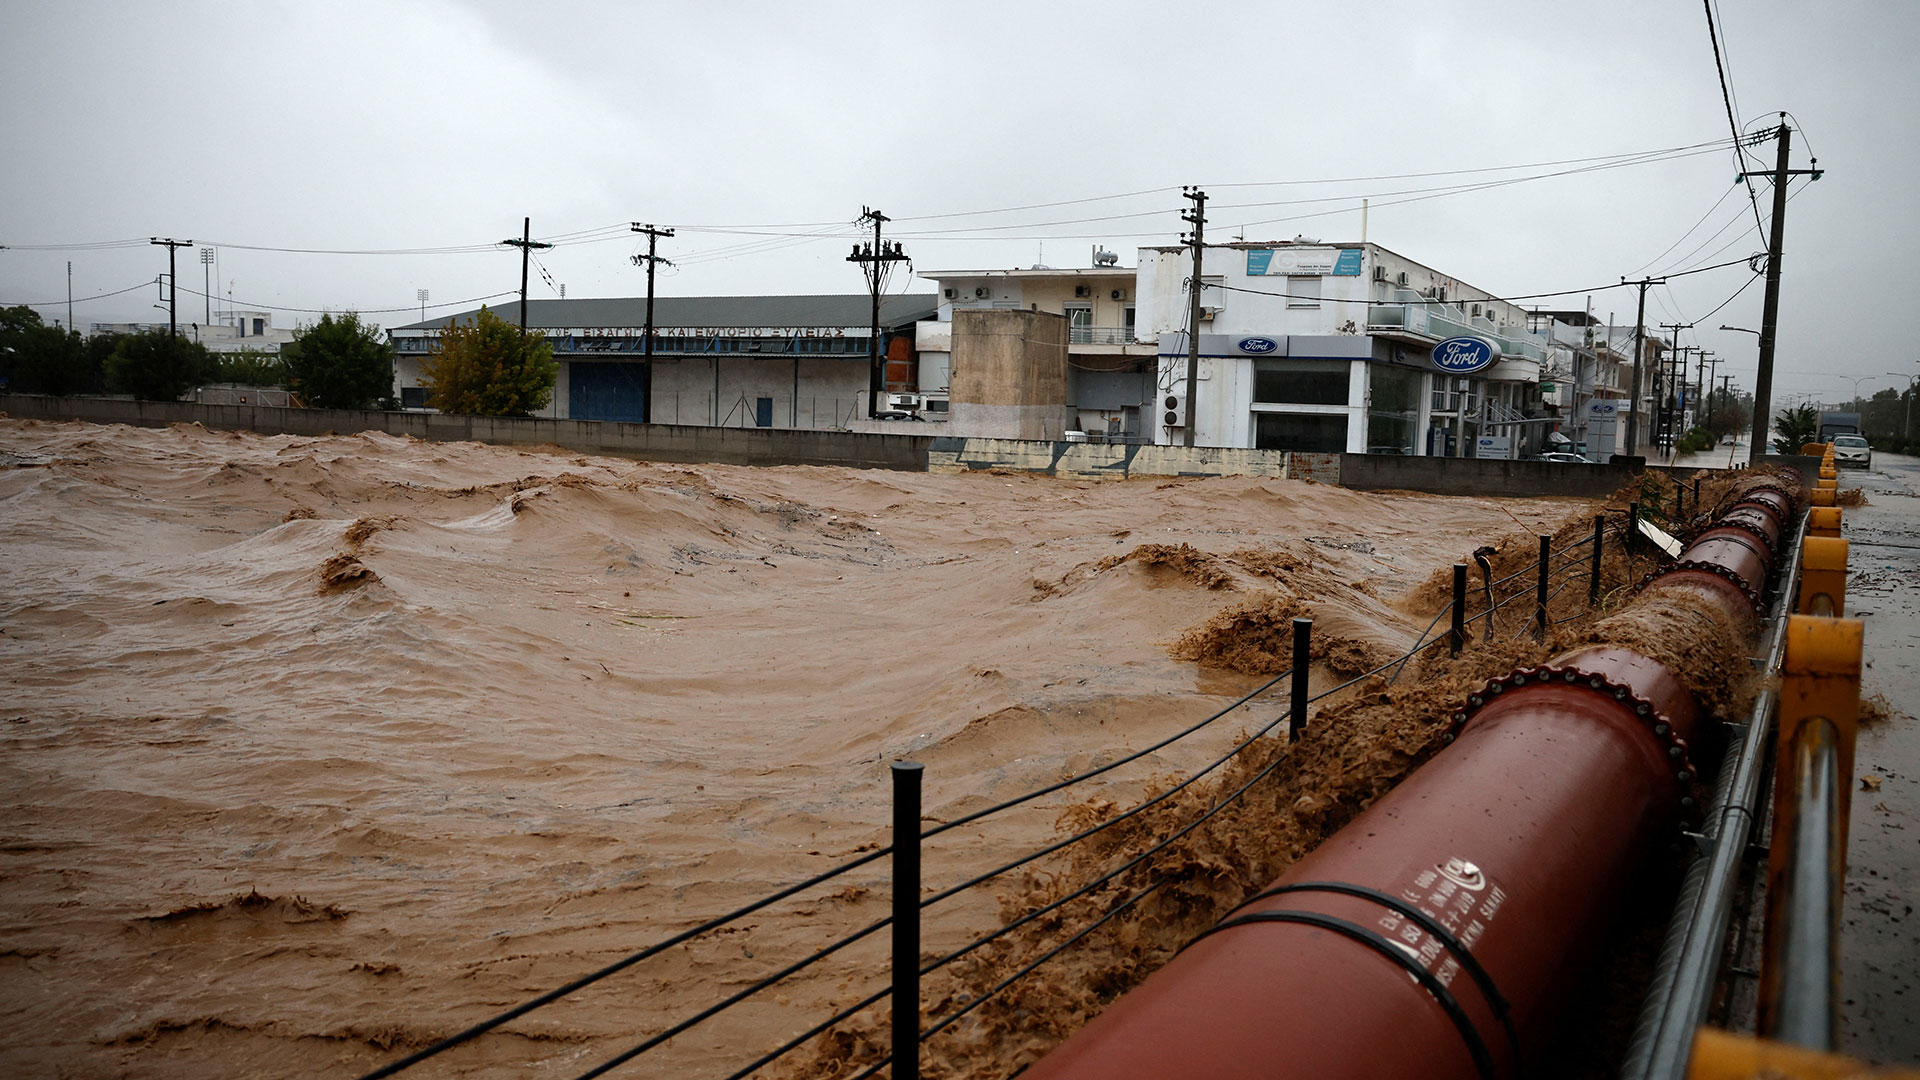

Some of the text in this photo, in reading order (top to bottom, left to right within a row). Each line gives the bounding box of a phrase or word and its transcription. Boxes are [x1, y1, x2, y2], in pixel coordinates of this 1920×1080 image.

[1244, 339, 1269, 351] Ford
[1442, 341, 1480, 366] Ford
[1400, 924, 1422, 945] ISO
